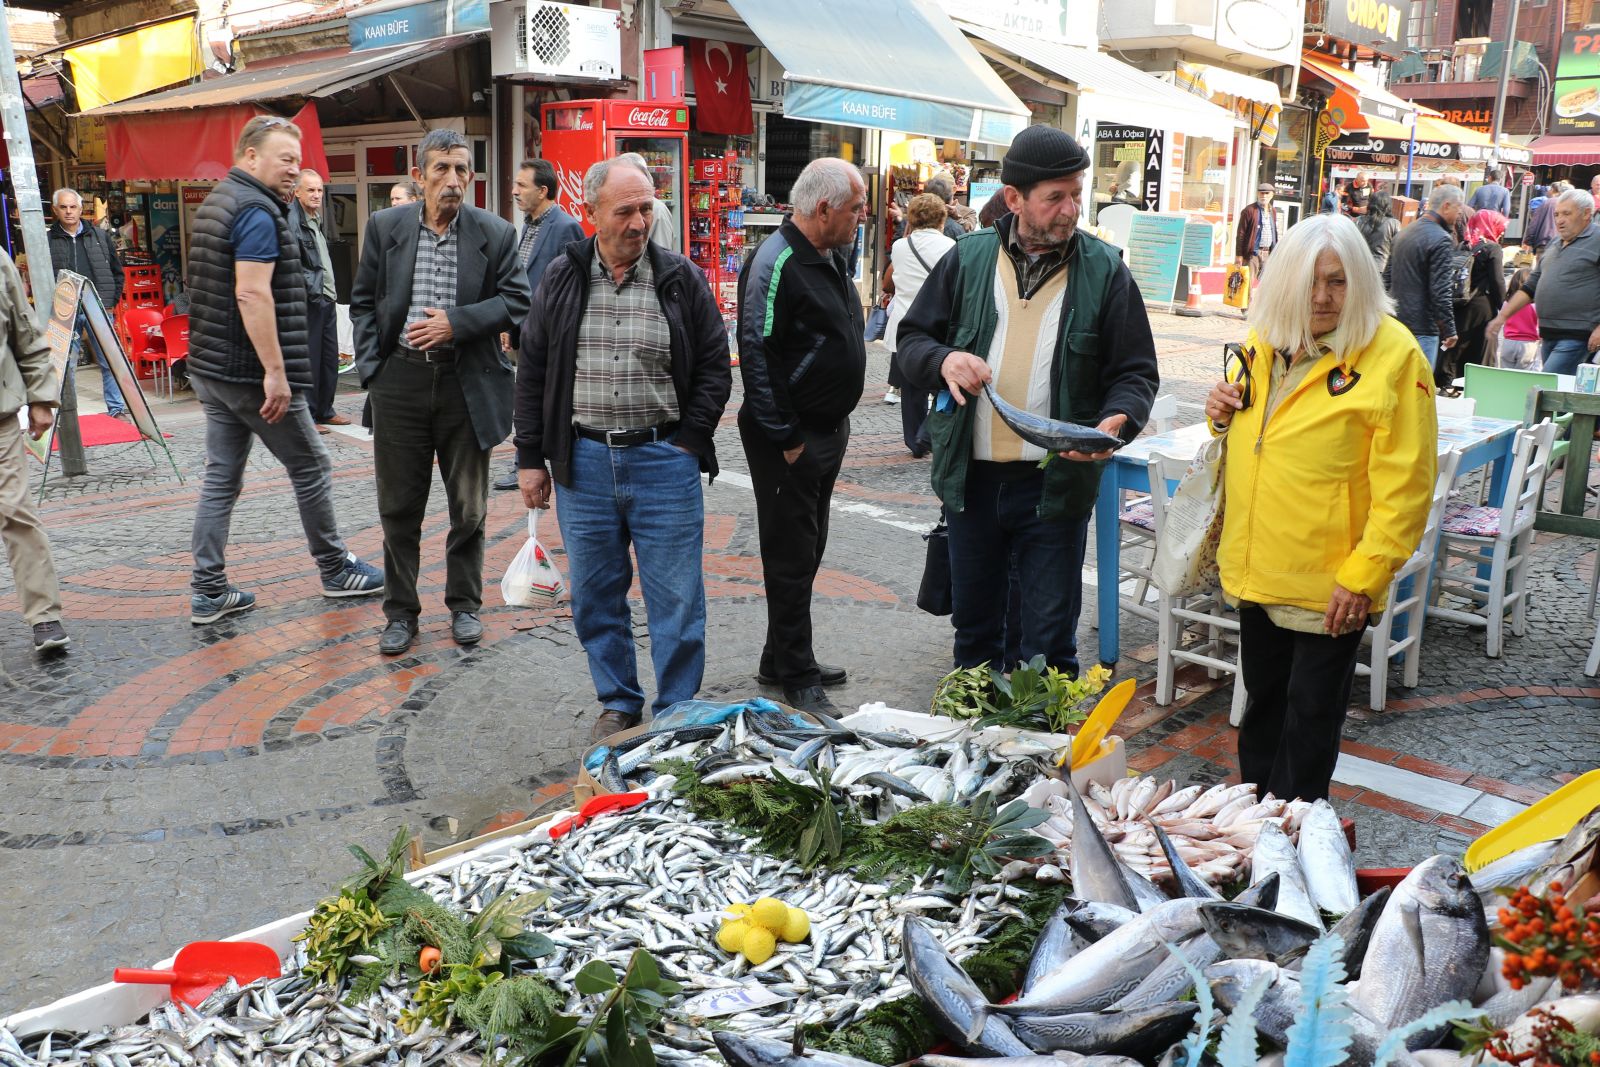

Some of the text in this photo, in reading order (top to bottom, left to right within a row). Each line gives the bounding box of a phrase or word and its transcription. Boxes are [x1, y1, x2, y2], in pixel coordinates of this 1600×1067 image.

[365, 19, 409, 39] KAAN BÜFE
[628, 107, 671, 127] Coca-Cola
[842, 101, 897, 121] KAAN BÜFE
[1096, 130, 1113, 138] АВА
[1123, 130, 1145, 139] Юфка
